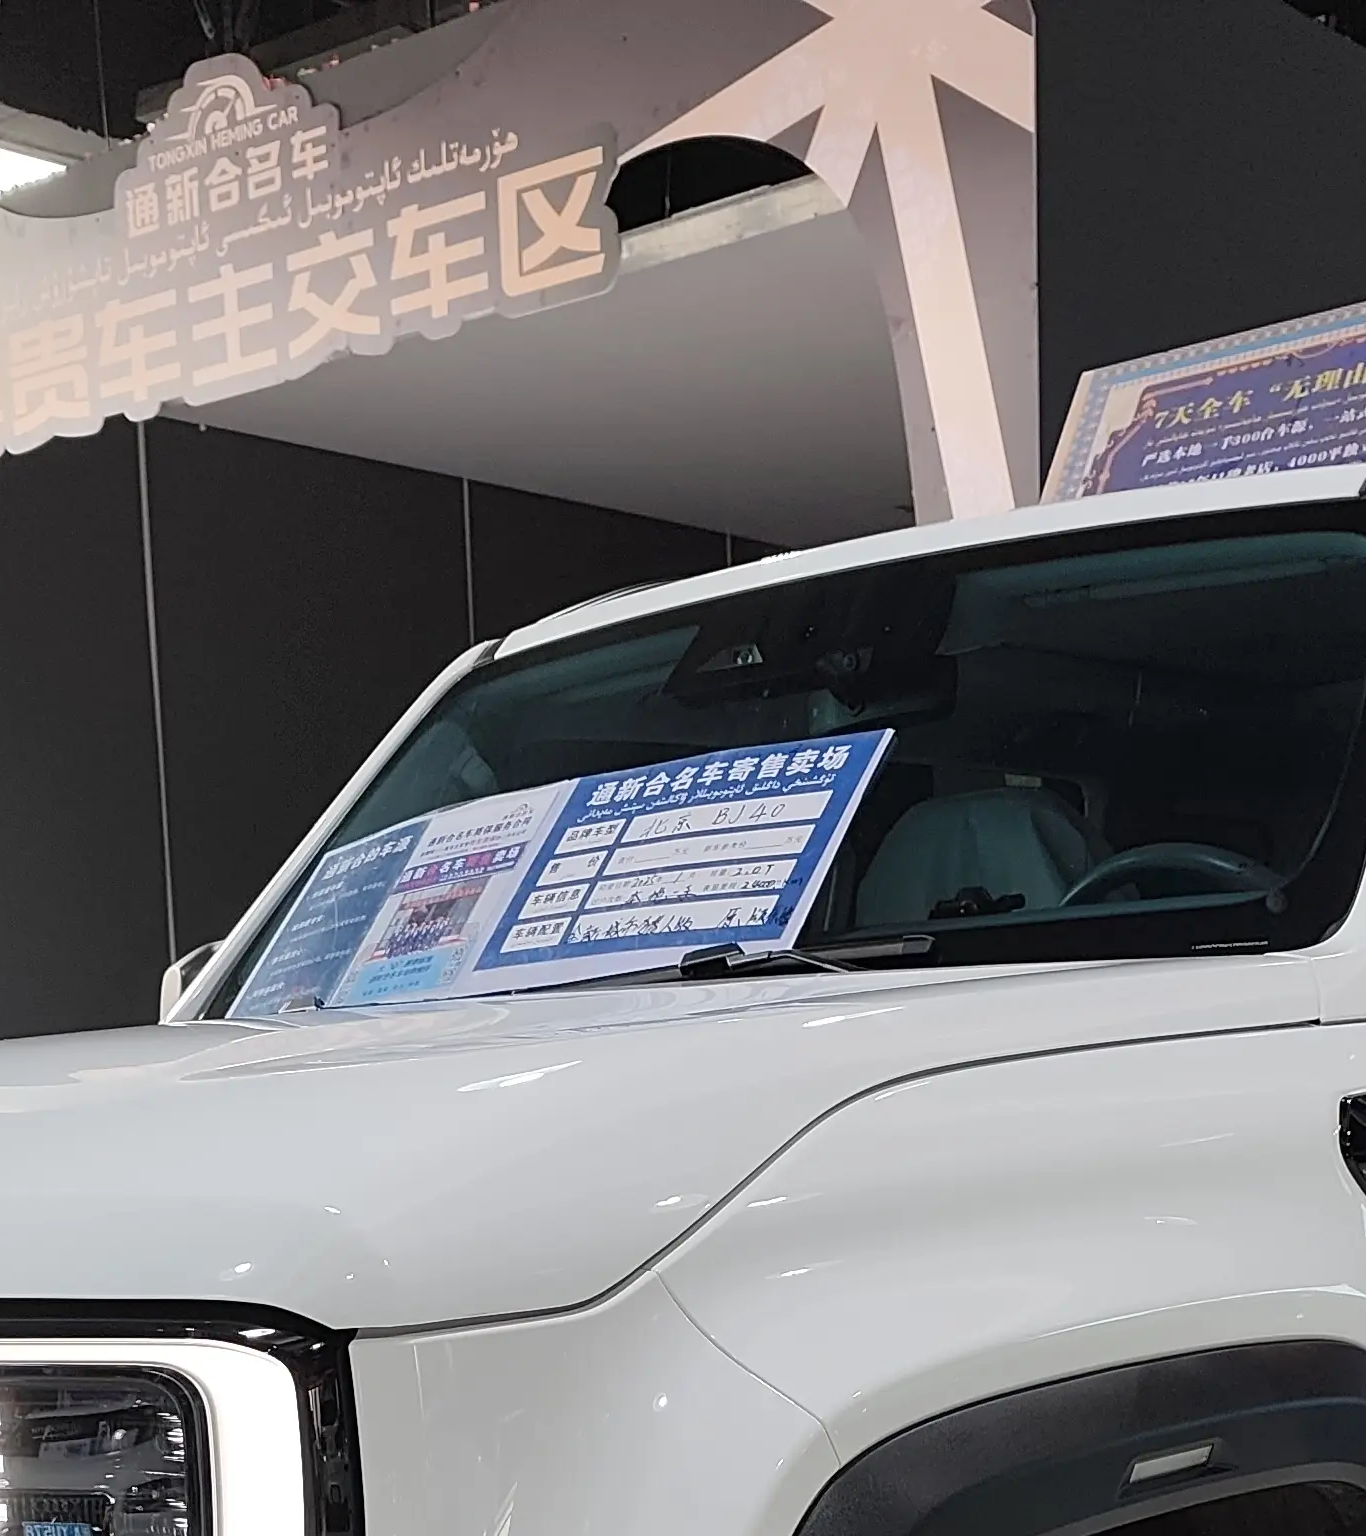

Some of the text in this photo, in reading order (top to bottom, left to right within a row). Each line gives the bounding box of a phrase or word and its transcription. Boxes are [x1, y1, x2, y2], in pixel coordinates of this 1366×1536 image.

[148, 106, 298, 172] TONGXIN HEMING CAR
[125, 126, 328, 239] 通新合名车
[587, 744, 852, 806] 通新合名车寄售卖场
[567, 824, 618, 843] 品牌车型
[640, 813, 692, 840] 北京
[531, 888, 582, 907] 车辆信息
[514, 922, 565, 940] 车辆配置
